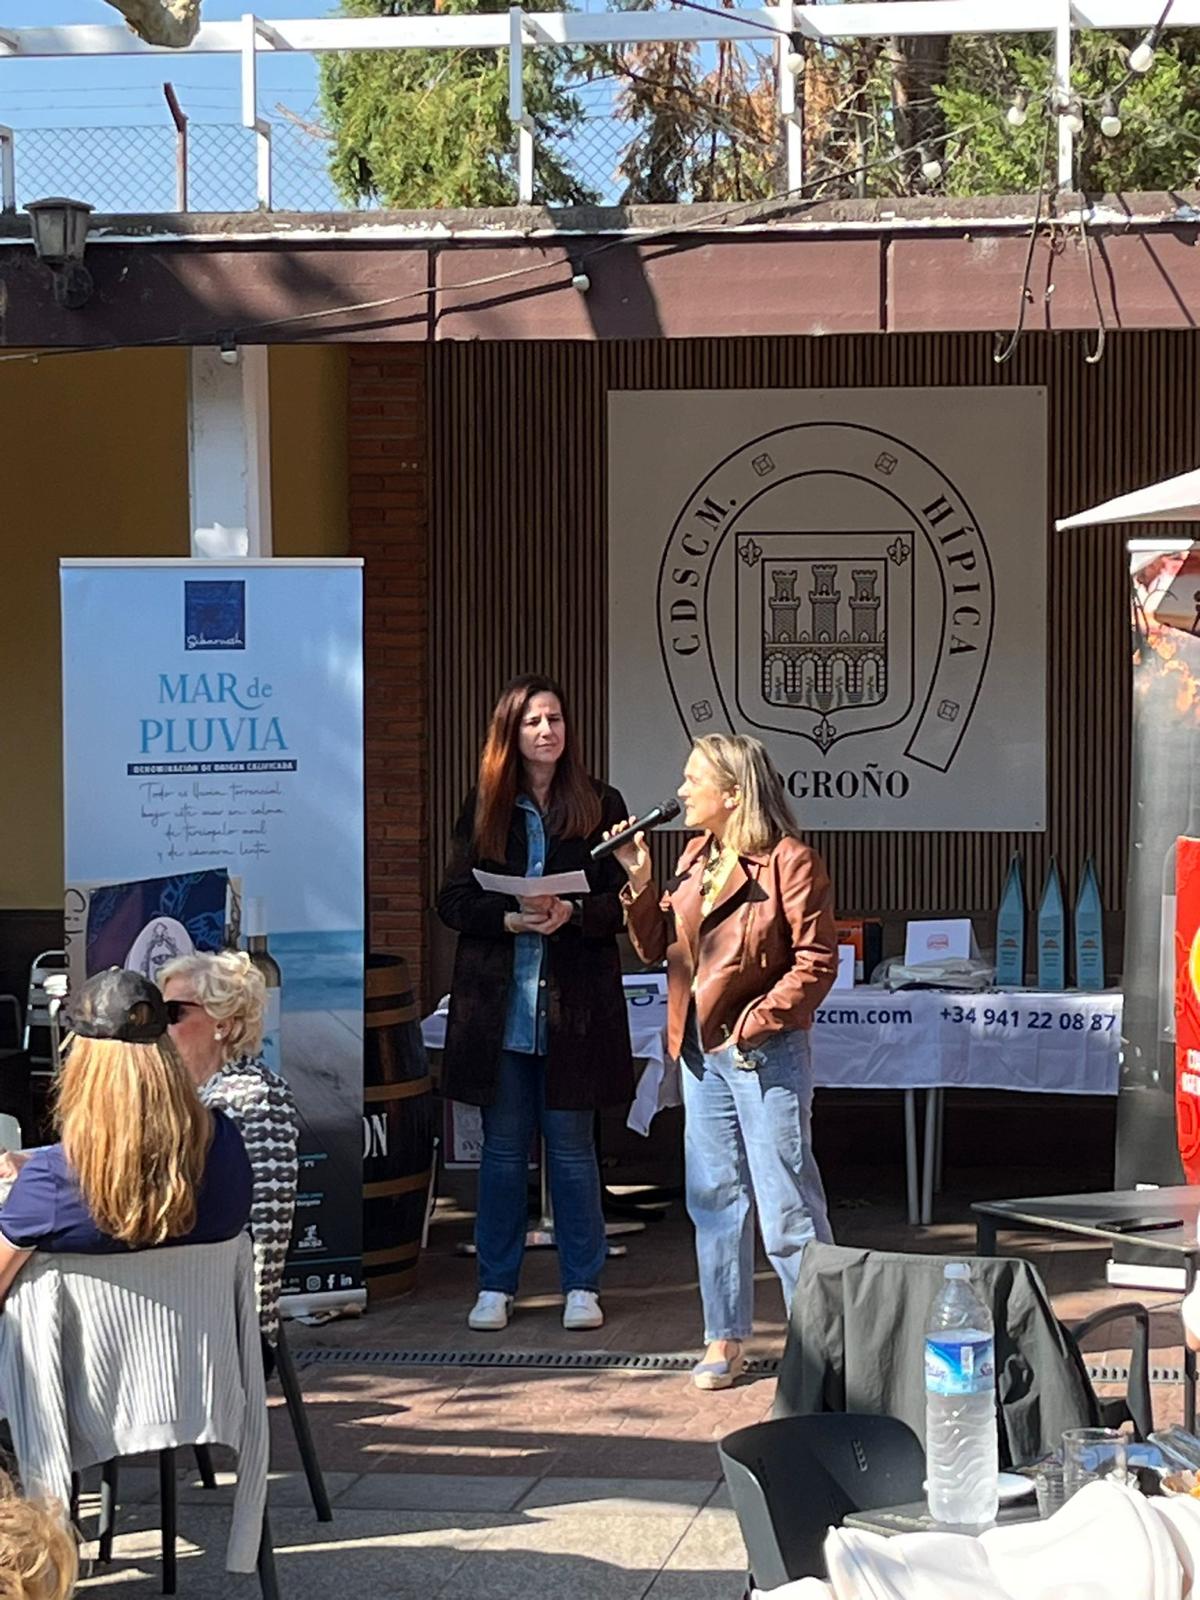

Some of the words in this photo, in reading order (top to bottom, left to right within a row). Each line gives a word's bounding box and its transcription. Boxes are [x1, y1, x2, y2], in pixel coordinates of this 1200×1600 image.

[921, 494, 981, 657] HÍPICA
[158, 672, 264, 710] MAR
[246, 677, 272, 698] de
[139, 716, 288, 754] PLUVIA
[940, 1006, 977, 1023] +34
[983, 1008, 1019, 1027] 941
[1027, 1012, 1052, 1029] 22
[1059, 1013, 1084, 1030] 08
[1091, 1014, 1116, 1031] 87
